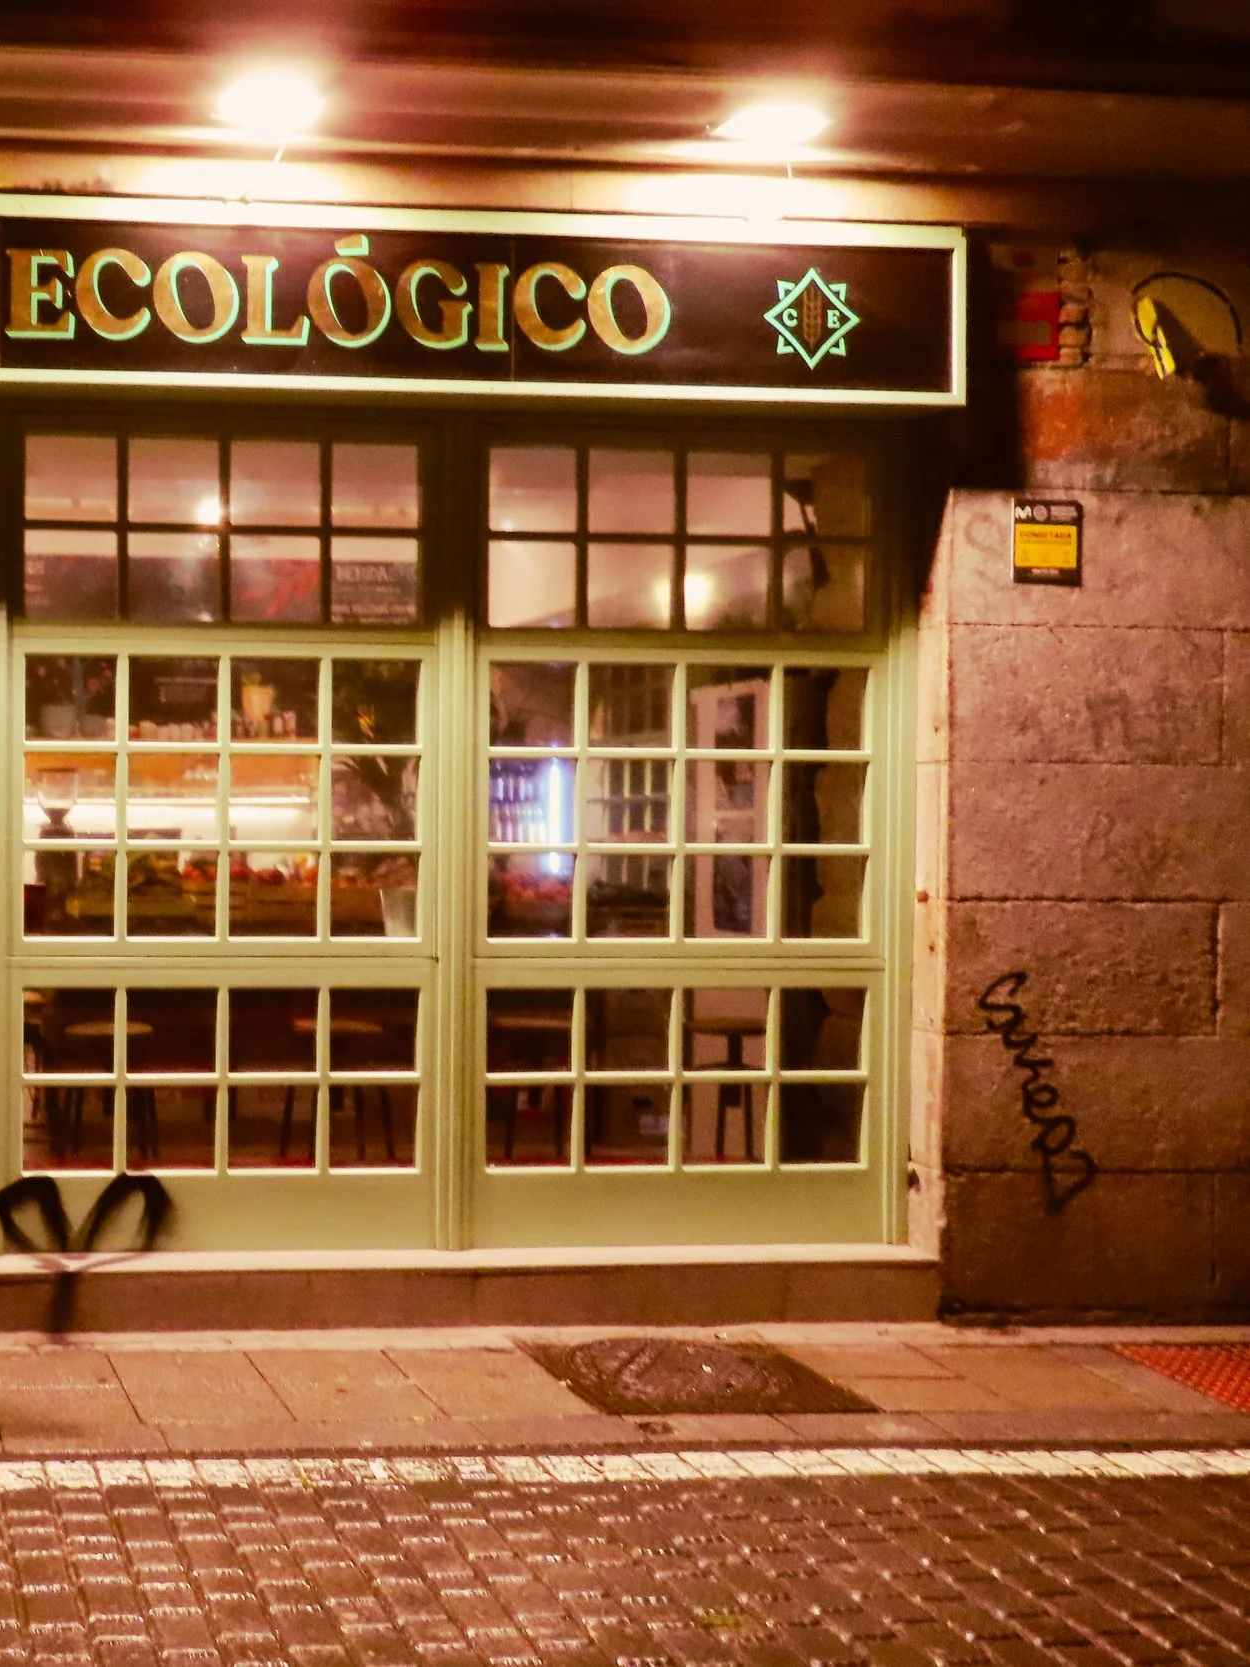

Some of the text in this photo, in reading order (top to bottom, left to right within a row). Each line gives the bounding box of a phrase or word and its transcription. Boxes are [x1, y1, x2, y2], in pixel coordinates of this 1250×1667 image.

[5, 234, 671, 356] ECOLÓGICO
[782, 307, 798, 328] C
[827, 309, 842, 329] E
